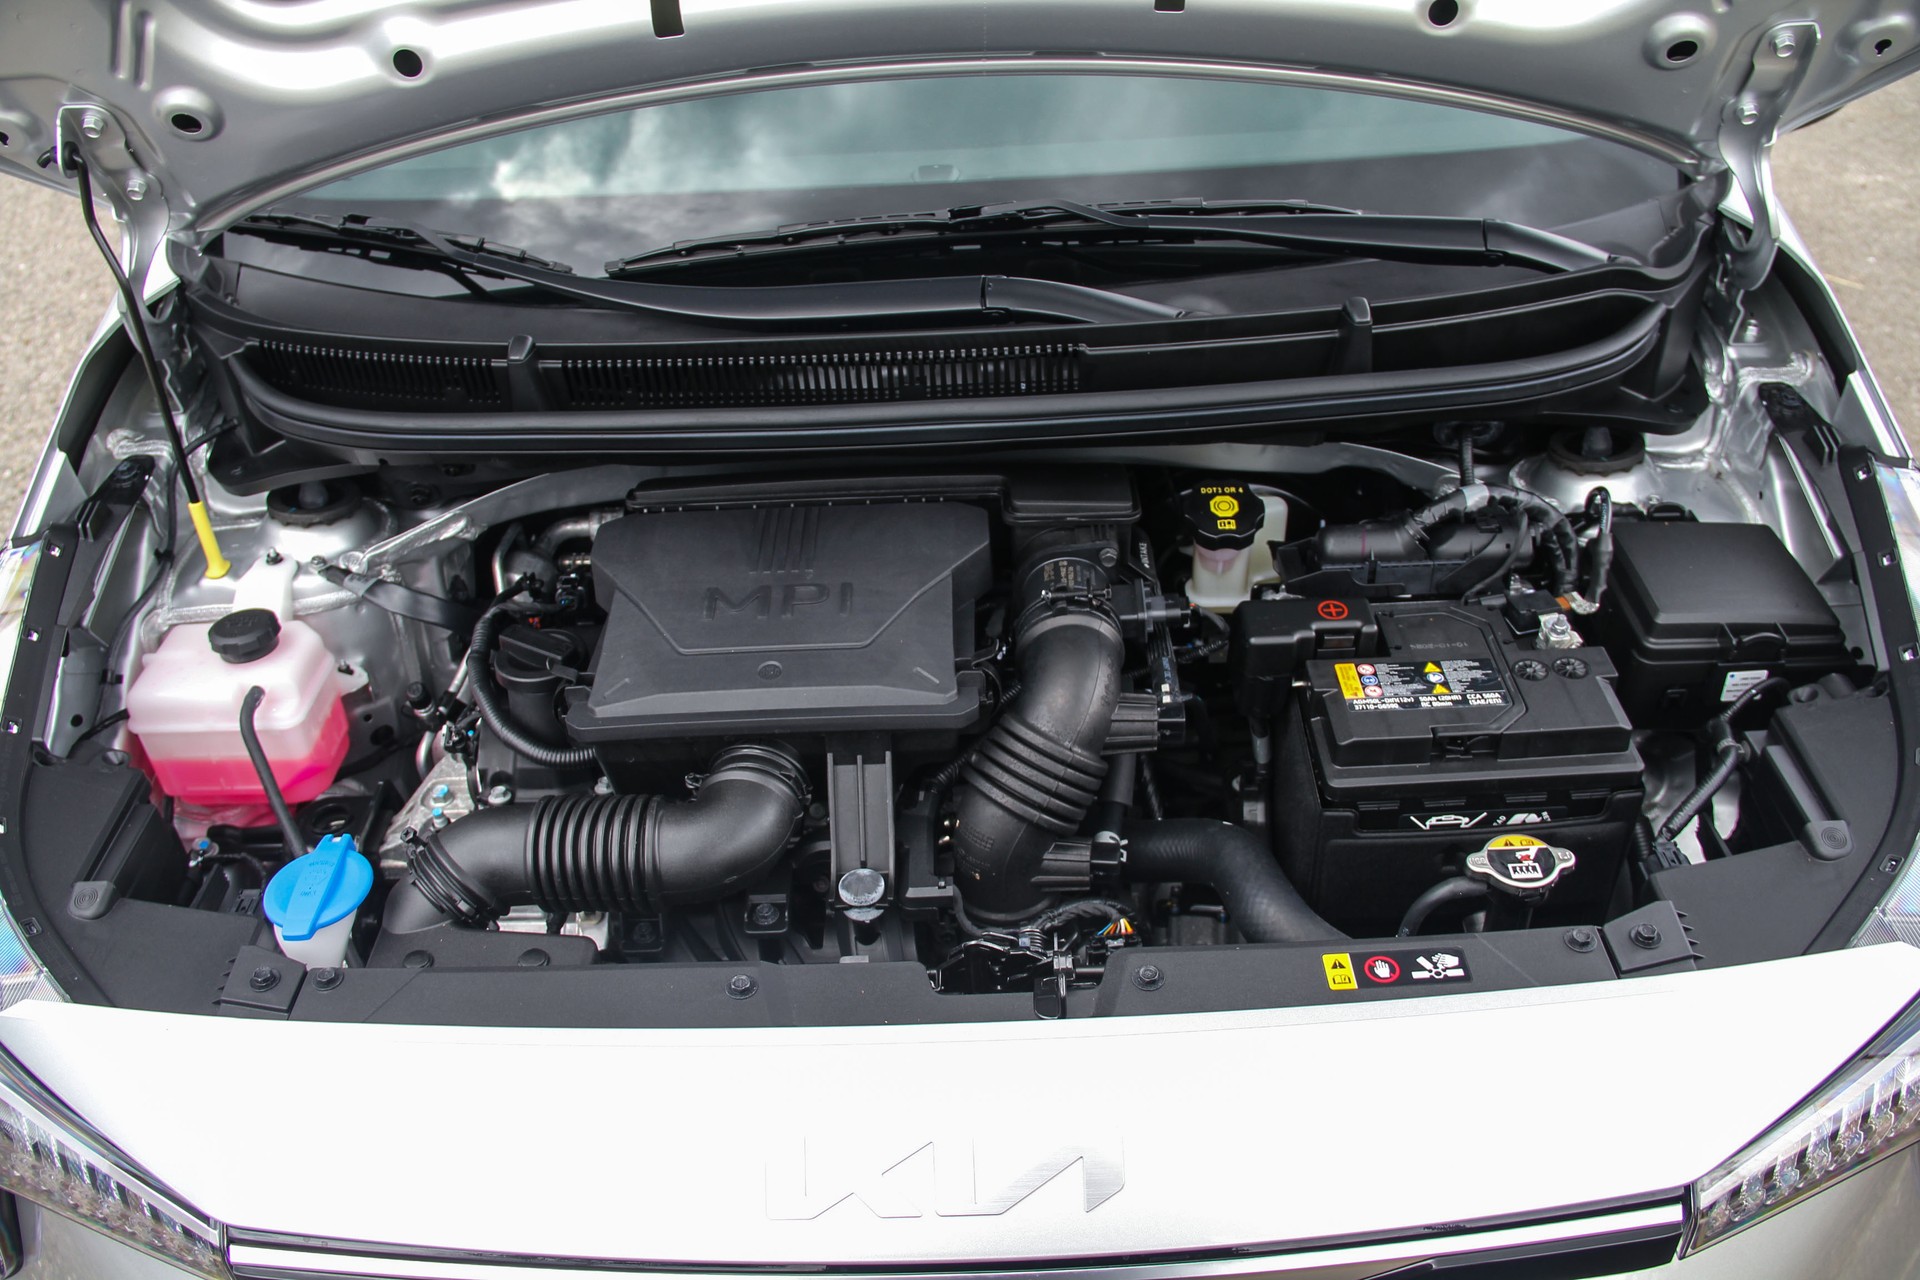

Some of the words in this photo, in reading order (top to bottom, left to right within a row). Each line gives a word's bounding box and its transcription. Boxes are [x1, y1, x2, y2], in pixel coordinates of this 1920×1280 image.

[1200, 486, 1222, 494] DOT3
[1223, 486, 1237, 494] OR
[1238, 486, 1244, 494] 4
[703, 581, 854, 621] MPI
[1418, 695, 1437, 703] 50Ah
